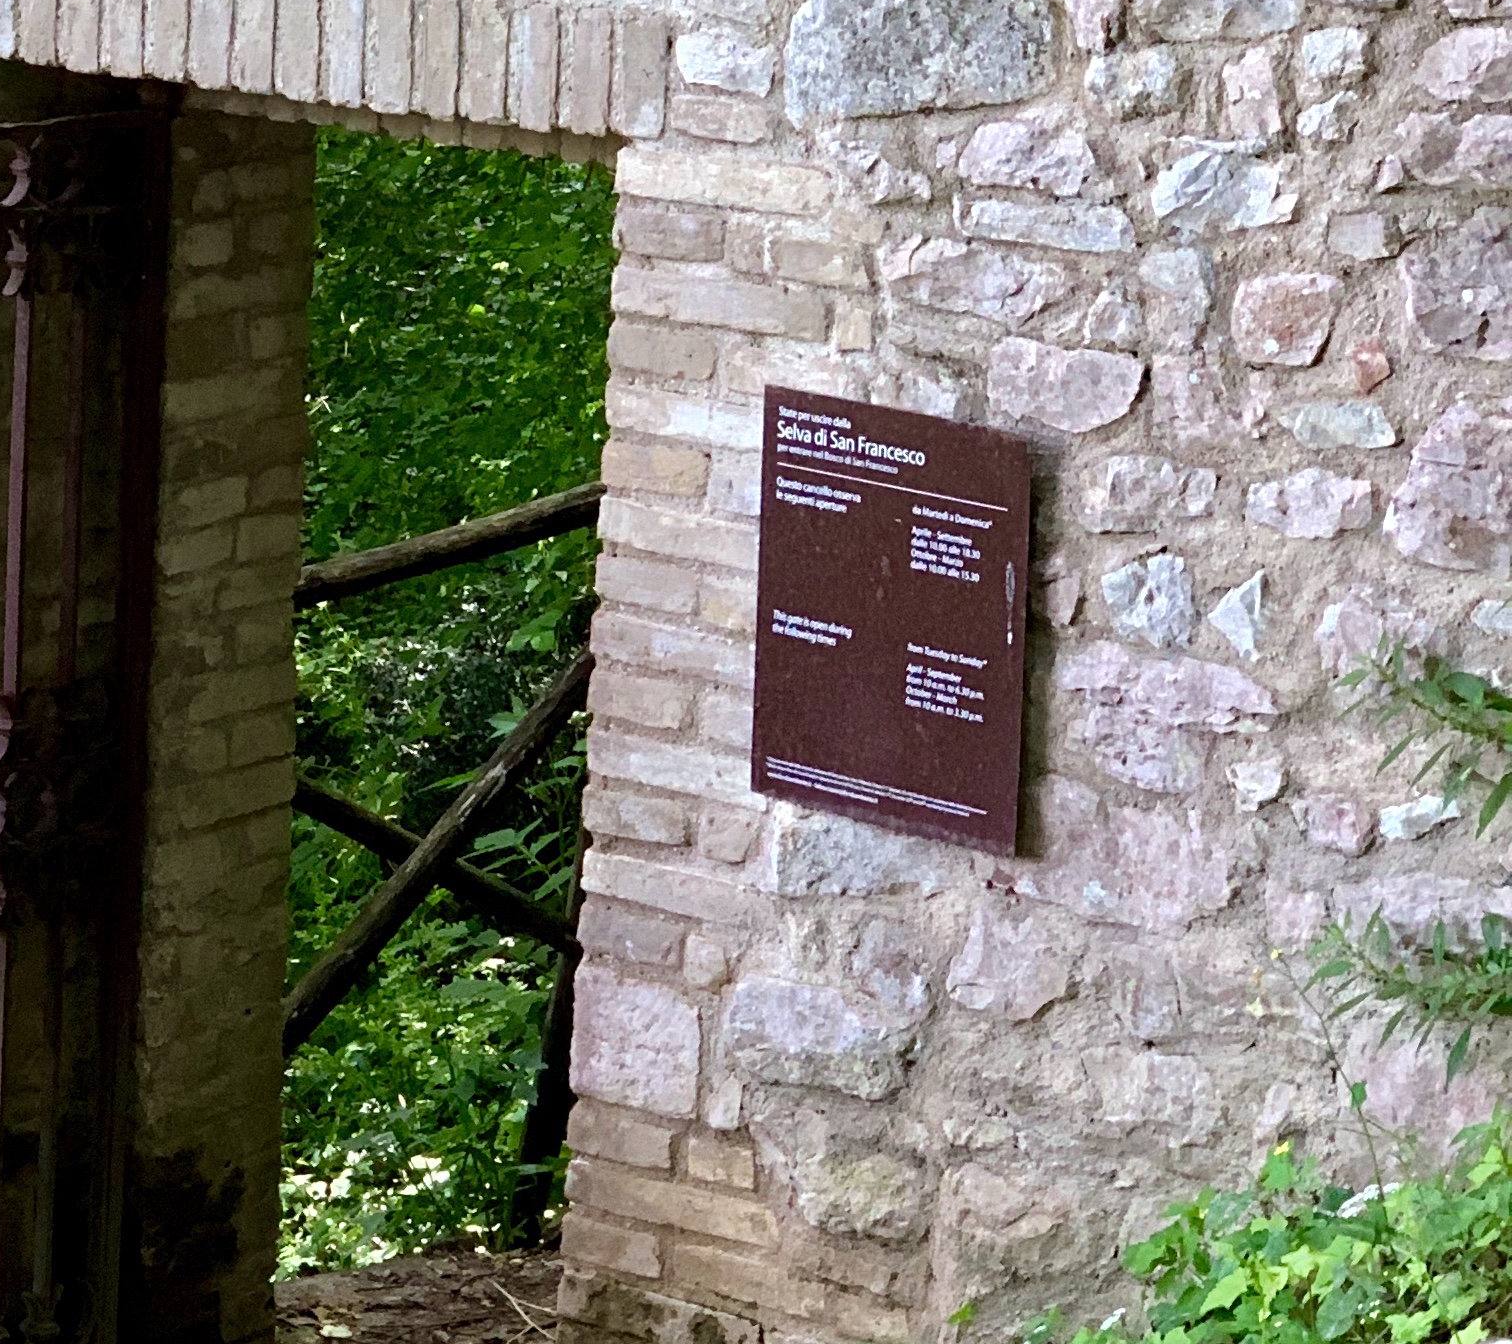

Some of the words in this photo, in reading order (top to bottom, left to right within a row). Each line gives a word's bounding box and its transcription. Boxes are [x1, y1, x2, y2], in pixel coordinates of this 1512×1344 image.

[777, 420, 812, 444] Selva
[814, 427, 828, 446] di
[830, 430, 855, 452] San
[858, 436, 926, 466] Francesco
